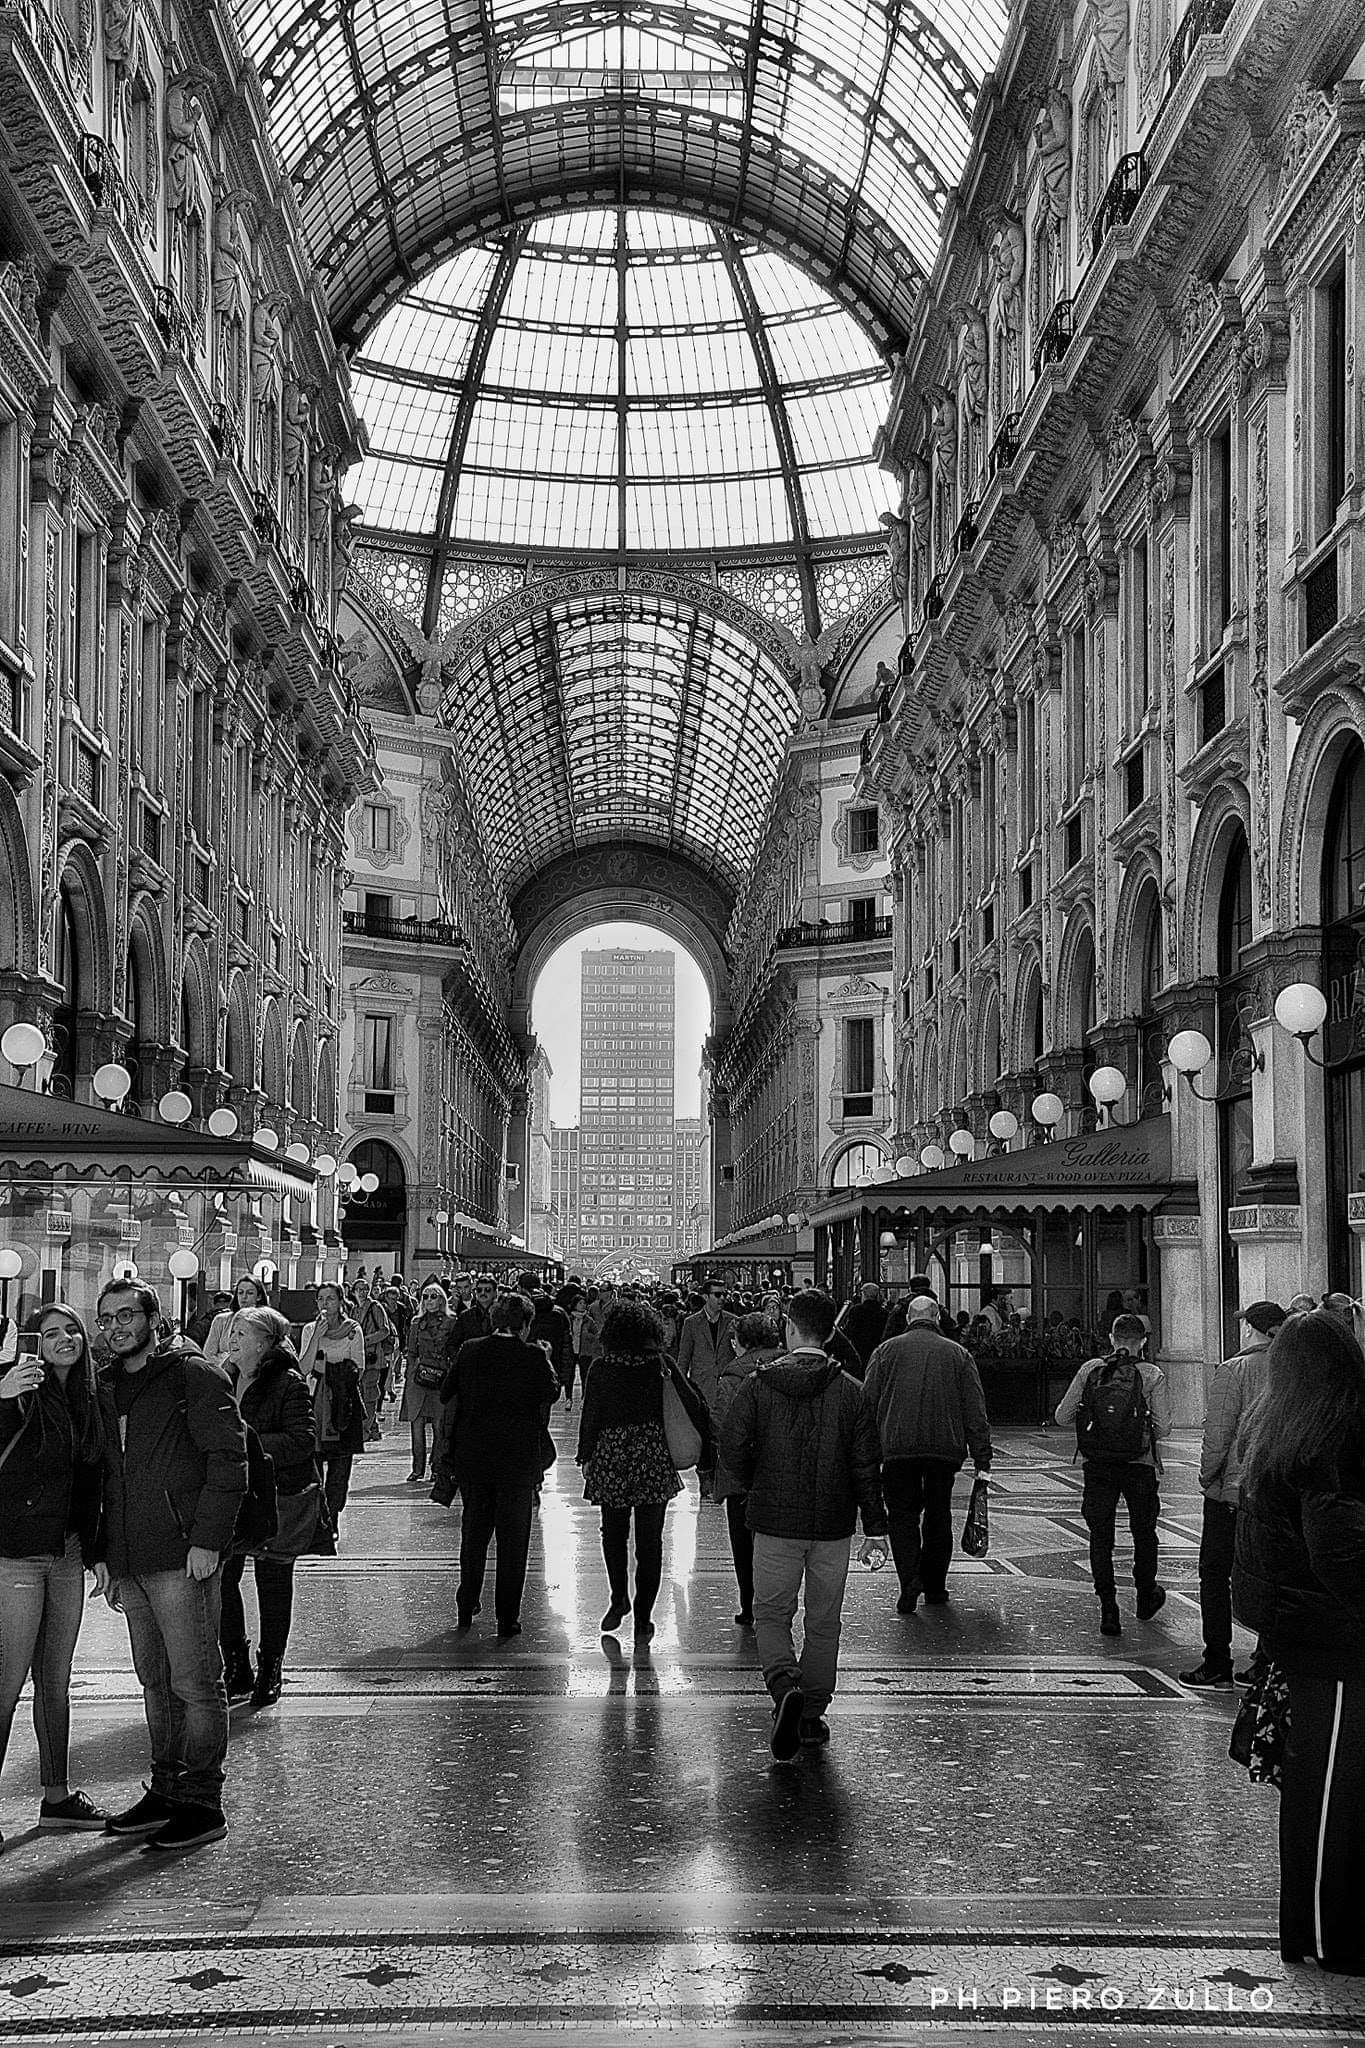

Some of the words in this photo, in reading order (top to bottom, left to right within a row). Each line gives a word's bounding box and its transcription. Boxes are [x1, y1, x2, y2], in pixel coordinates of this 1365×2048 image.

[612, 953, 645, 961] MARTINI
[62, 1123, 101, 1135] WINE
[1061, 1142, 1151, 1167] Galleria
[963, 1173, 1036, 1183] RESTAURANT
[1047, 1173, 1082, 1182] WOOD
[1084, 1172, 1115, 1182] OVEN
[1118, 1171, 1151, 1182] PIZZA
